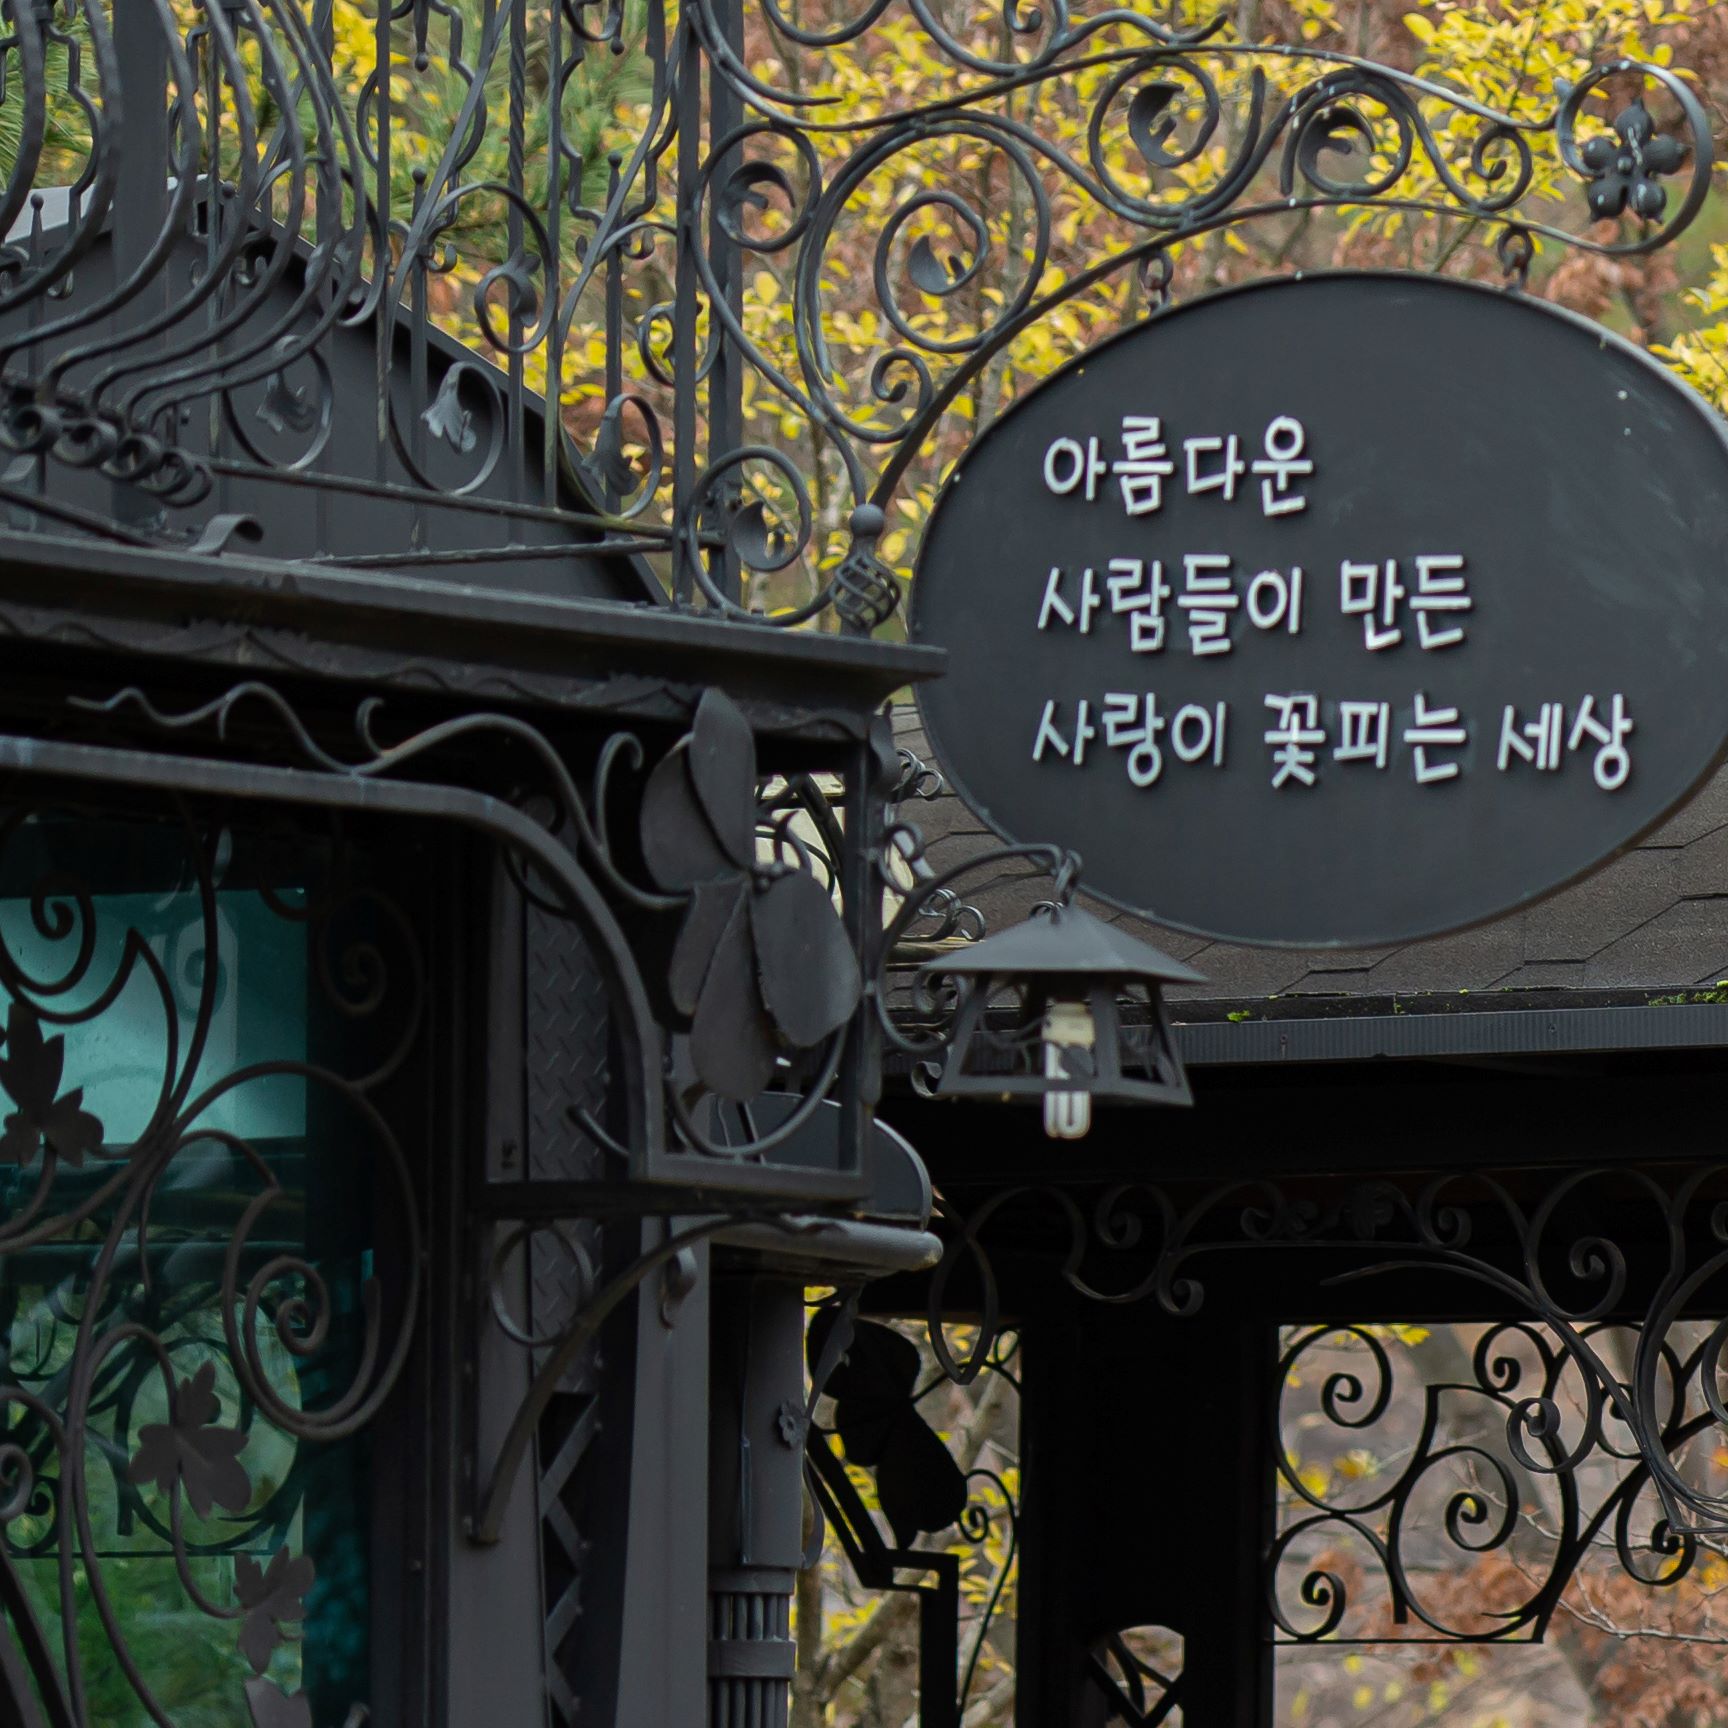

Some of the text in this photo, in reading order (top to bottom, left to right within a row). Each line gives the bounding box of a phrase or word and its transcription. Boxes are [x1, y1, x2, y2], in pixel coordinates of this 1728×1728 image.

[1044, 415, 1313, 516] 아름다운
[1037, 554, 1471, 655] 사람들이 만든
[1032, 692, 1633, 789] 사랑이 꽃피는 세상
